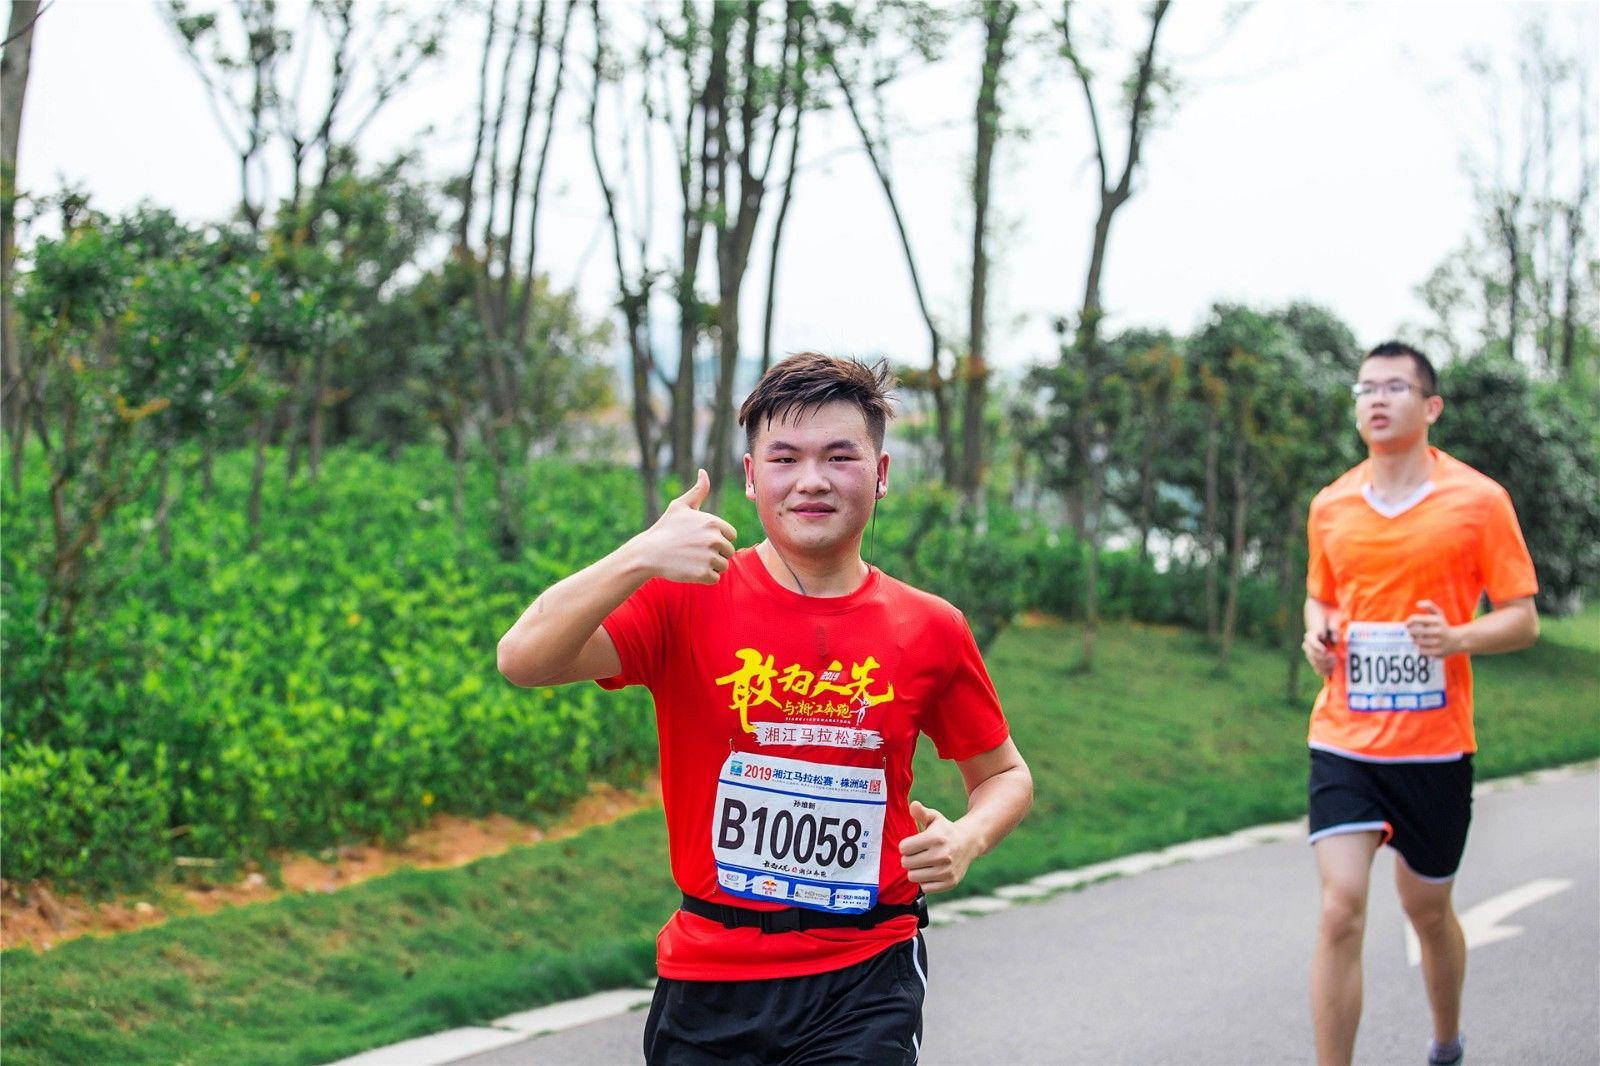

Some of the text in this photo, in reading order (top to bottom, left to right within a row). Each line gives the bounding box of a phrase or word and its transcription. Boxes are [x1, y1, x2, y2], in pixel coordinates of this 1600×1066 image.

[820, 670, 841, 681] 2019
[1350, 653, 1430, 684] B10598
[715, 648, 895, 733] 敢为人先
[783, 700, 852, 719] 与湘江奔跑
[764, 727, 868, 746] 湘江马拉松赛
[717, 797, 862, 868] B10058
